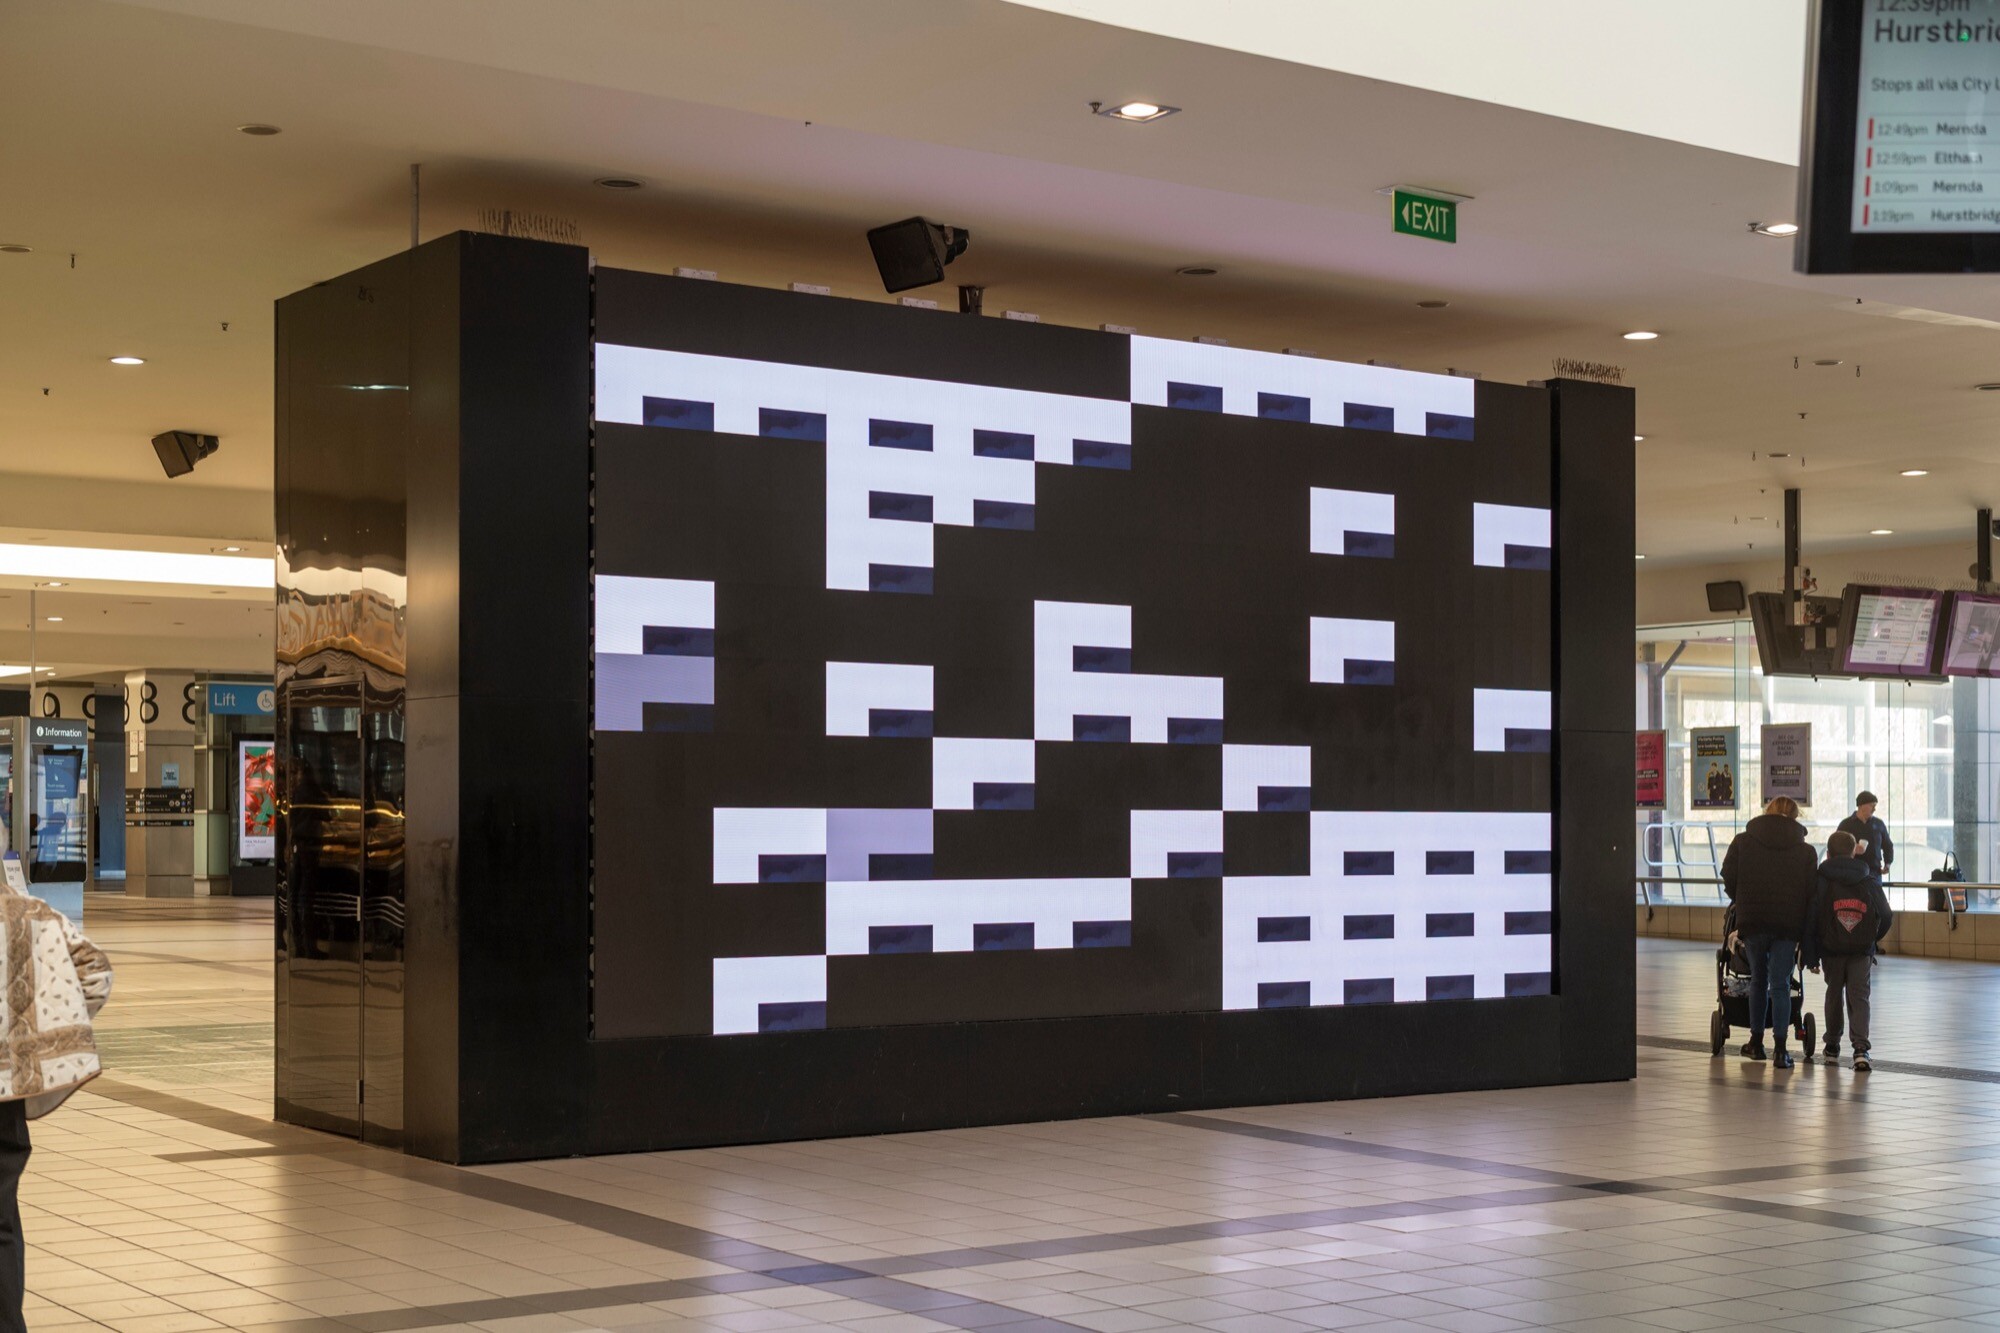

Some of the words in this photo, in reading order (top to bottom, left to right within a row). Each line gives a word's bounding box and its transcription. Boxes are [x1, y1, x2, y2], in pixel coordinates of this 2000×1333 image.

[1871, 77, 1912, 94] Stops
[1917, 78, 1934, 91] all
[1938, 78, 1958, 91] via
[1962, 77, 1991, 94] City
[1936, 122, 1987, 135] Mernda
[1933, 180, 1983, 193] Mernda
[1412, 201, 1449, 234] EXIT
[140, 680, 159, 724] 8
[214, 693, 236, 706] Lift
[45, 727, 82, 737] Information
